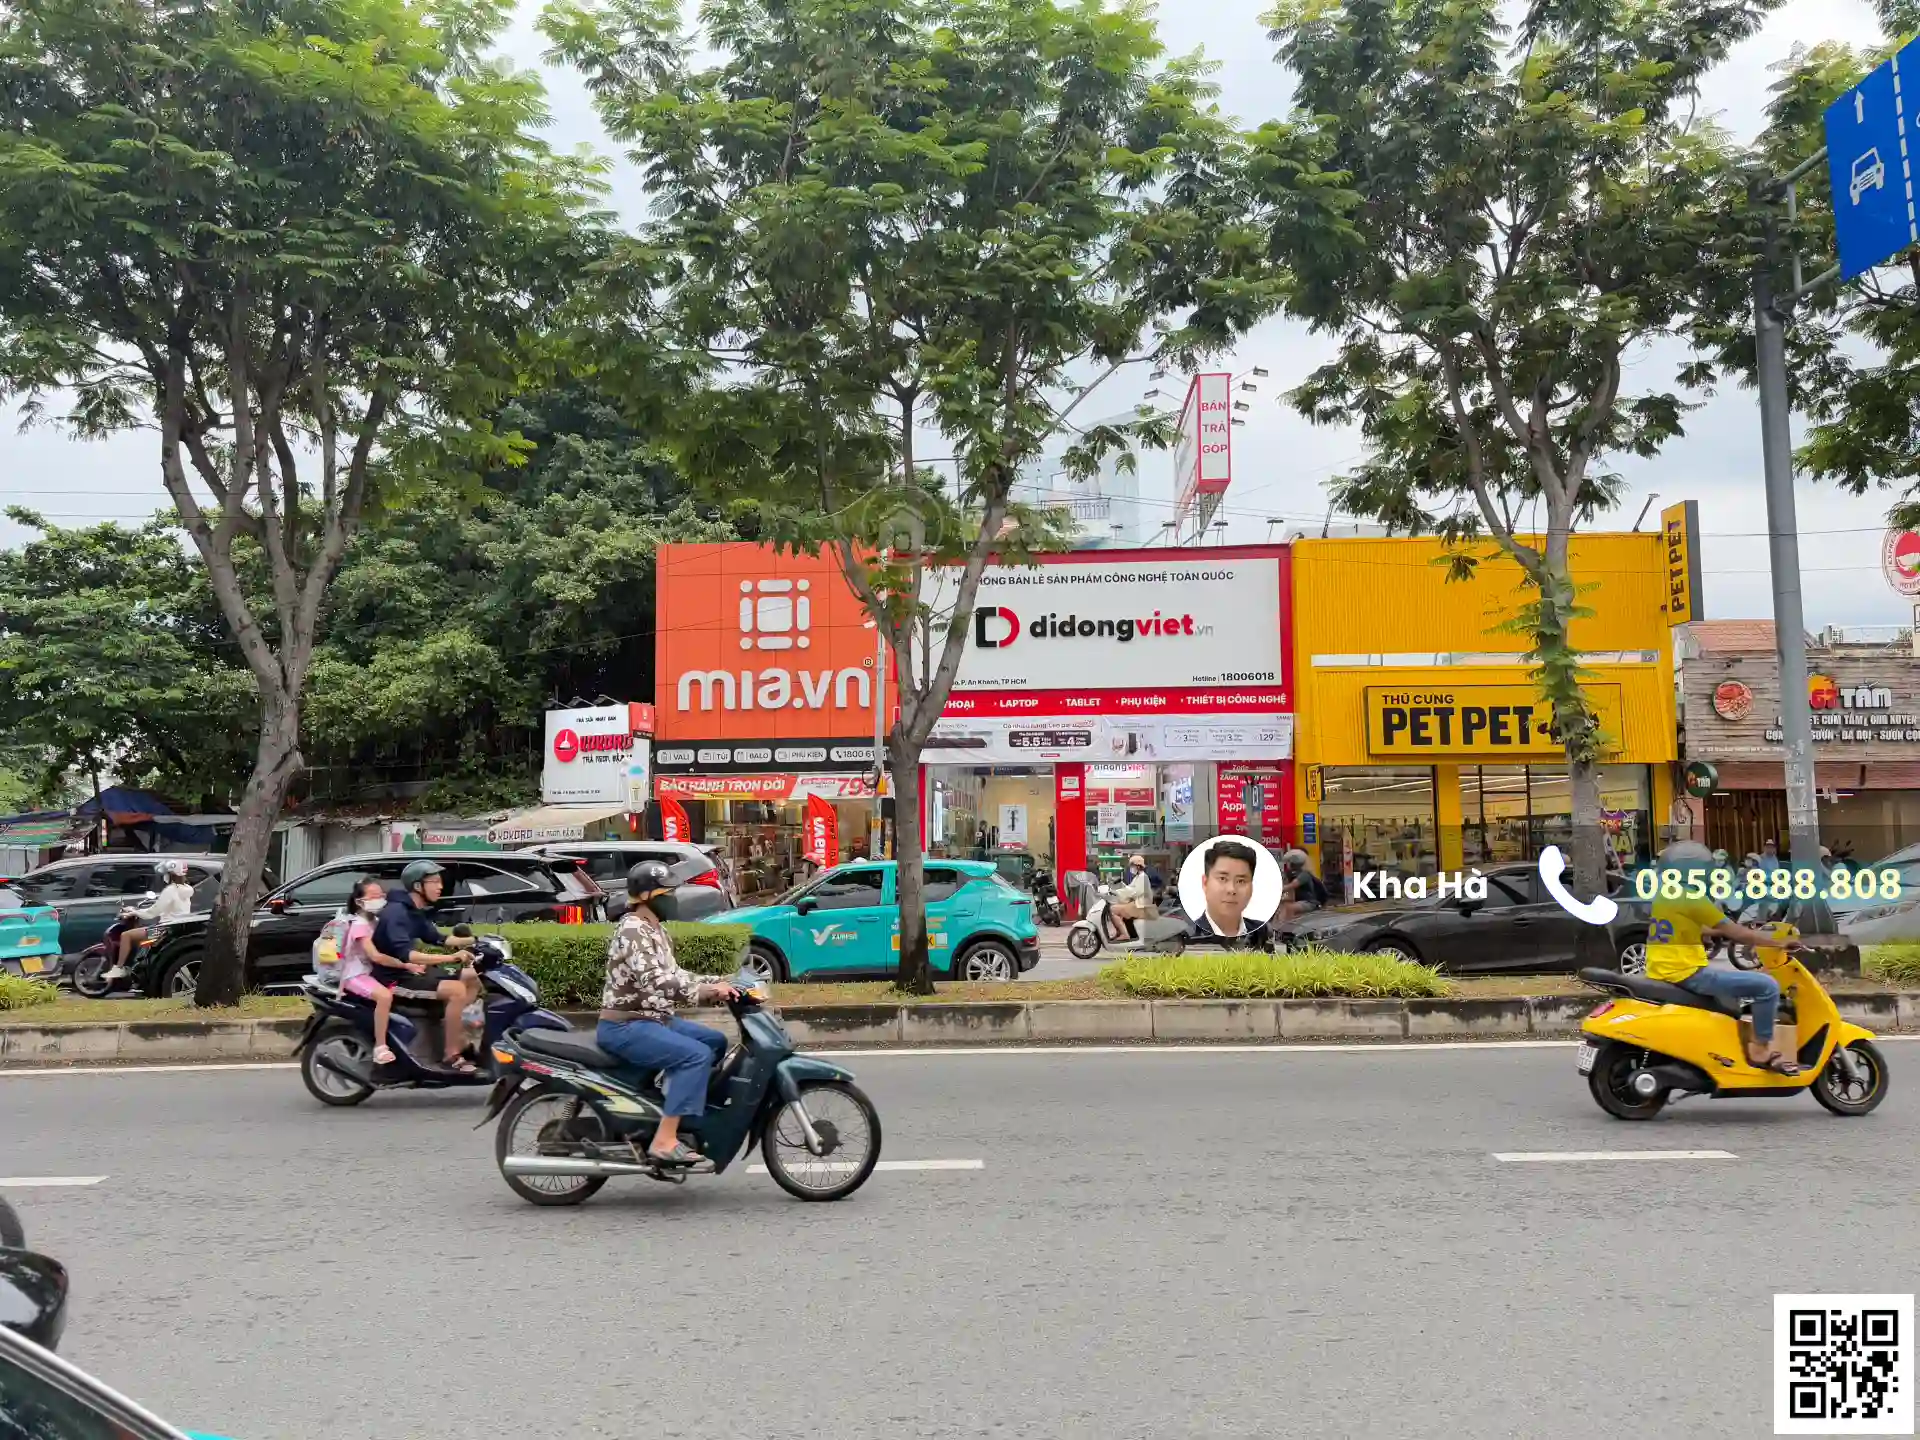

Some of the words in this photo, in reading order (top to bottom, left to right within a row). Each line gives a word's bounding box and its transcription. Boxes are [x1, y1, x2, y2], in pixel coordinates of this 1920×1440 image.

[1104, 572, 1136, 584] CÔNG
[1138, 571, 1168, 584] NGHỆ
[1011, 675, 1027, 684] HCM
[1220, 672, 1275, 682] 18006018
[999, 699, 1039, 708] LAPTOP
[1065, 697, 1101, 707] TABLET
[1227, 694, 1257, 704] CÔNG
[843, 750, 864, 758] 1800
